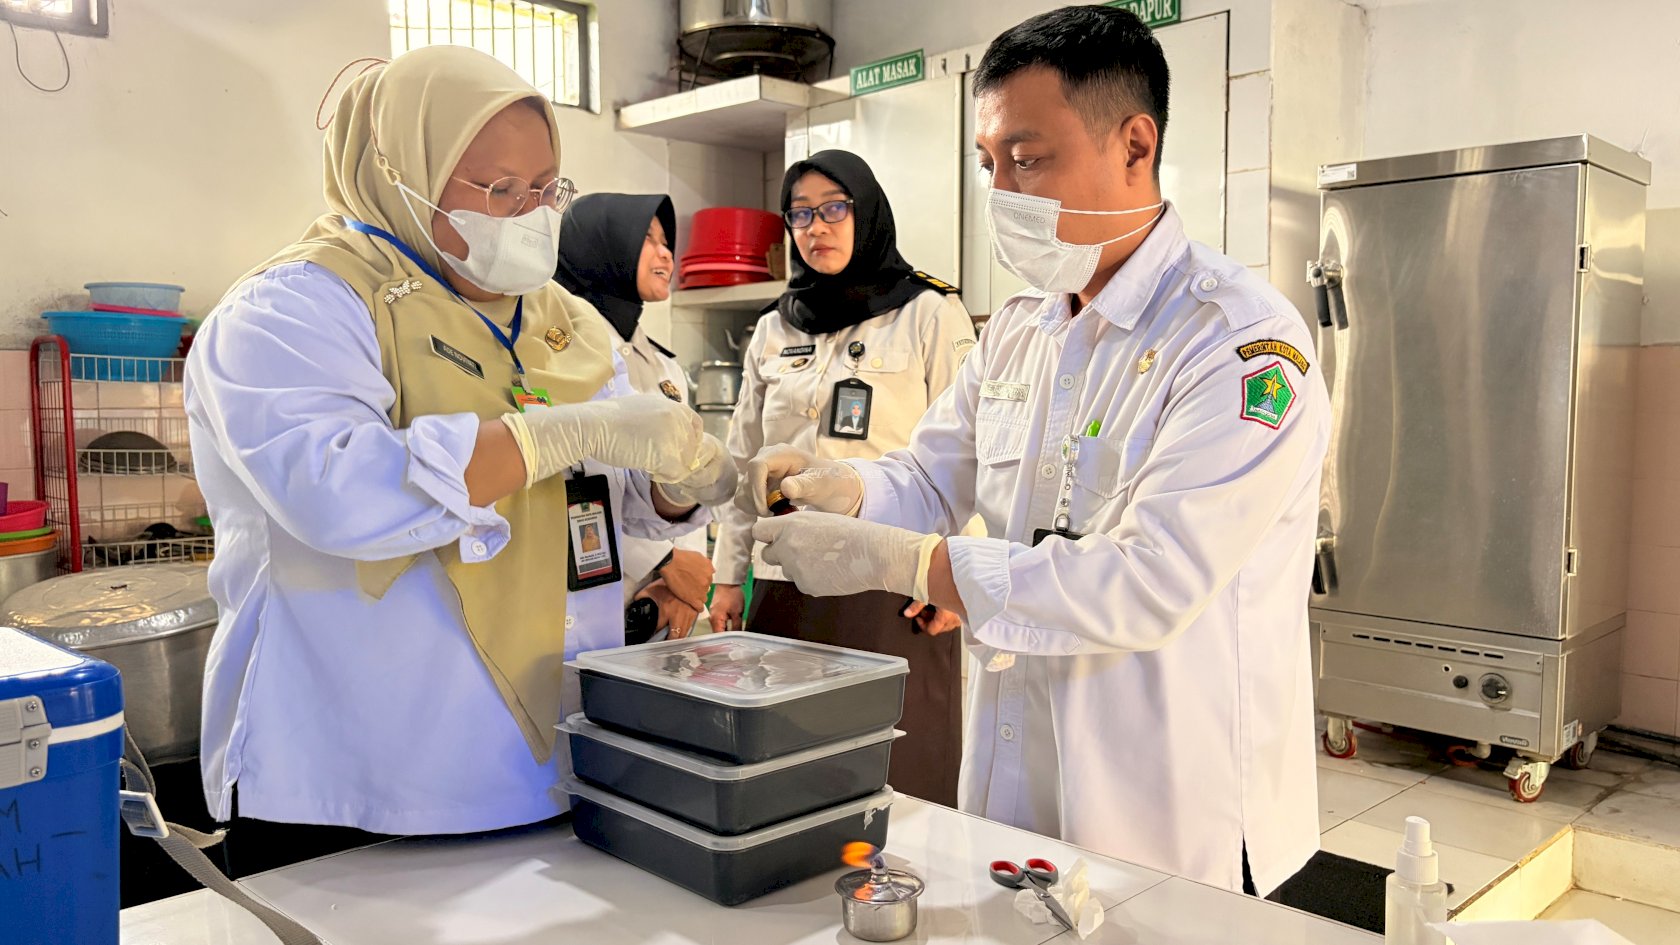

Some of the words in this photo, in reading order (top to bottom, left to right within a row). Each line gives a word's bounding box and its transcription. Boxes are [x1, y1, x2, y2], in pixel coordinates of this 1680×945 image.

[1129, 0, 1173, 22] DAPUR
[856, 67, 880, 90] ALAT
[882, 57, 917, 83] MASAK
[1013, 211, 1046, 224] ONEMED
[1241, 343, 1277, 358] PEMERINTAH
[1280, 344, 1292, 357] KOTA
